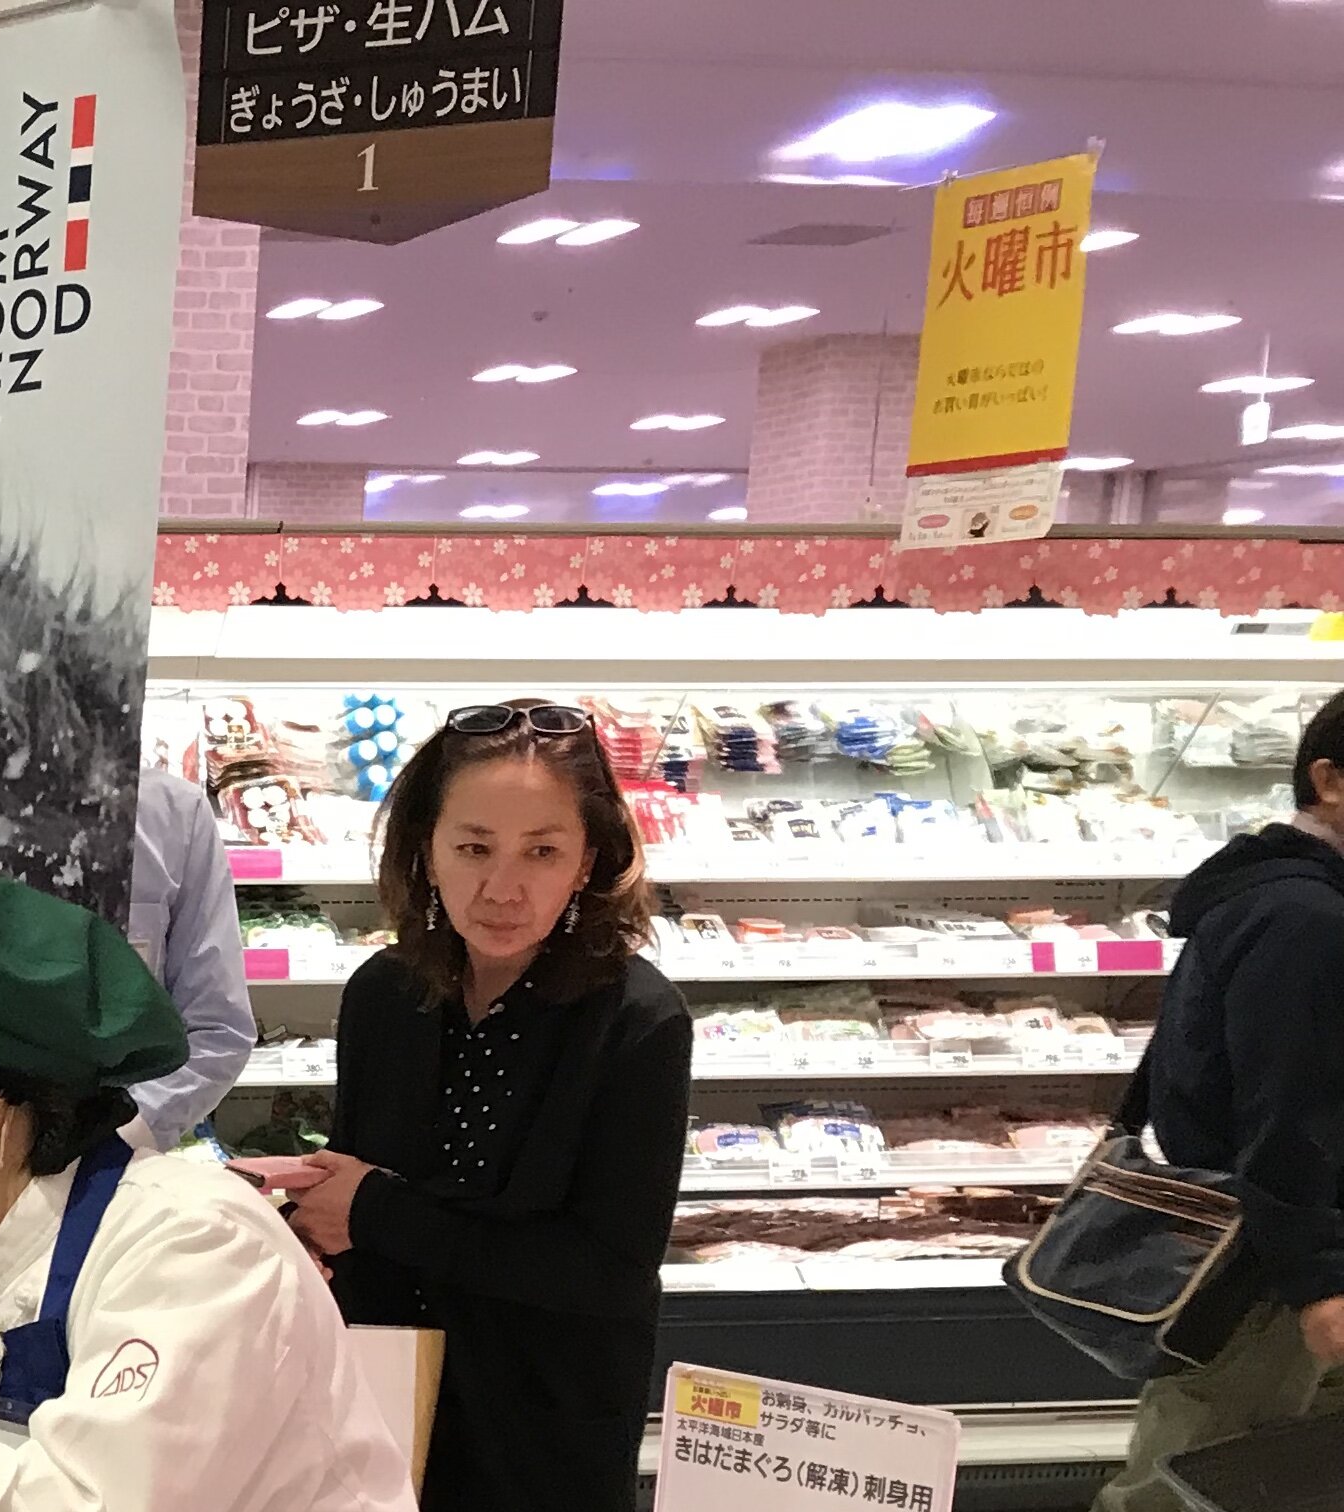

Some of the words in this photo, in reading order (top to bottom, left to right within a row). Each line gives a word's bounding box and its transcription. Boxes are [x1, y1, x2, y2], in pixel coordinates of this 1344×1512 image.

[246, 0, 510, 55] ピザ・生ハム
[230, 66, 523, 133] ぎょうざ・しゅうまい
[357, 143, 379, 192] 1
[936, 220, 1079, 311] 火曜市
[760, 1411, 837, 1442] サラダ等に
